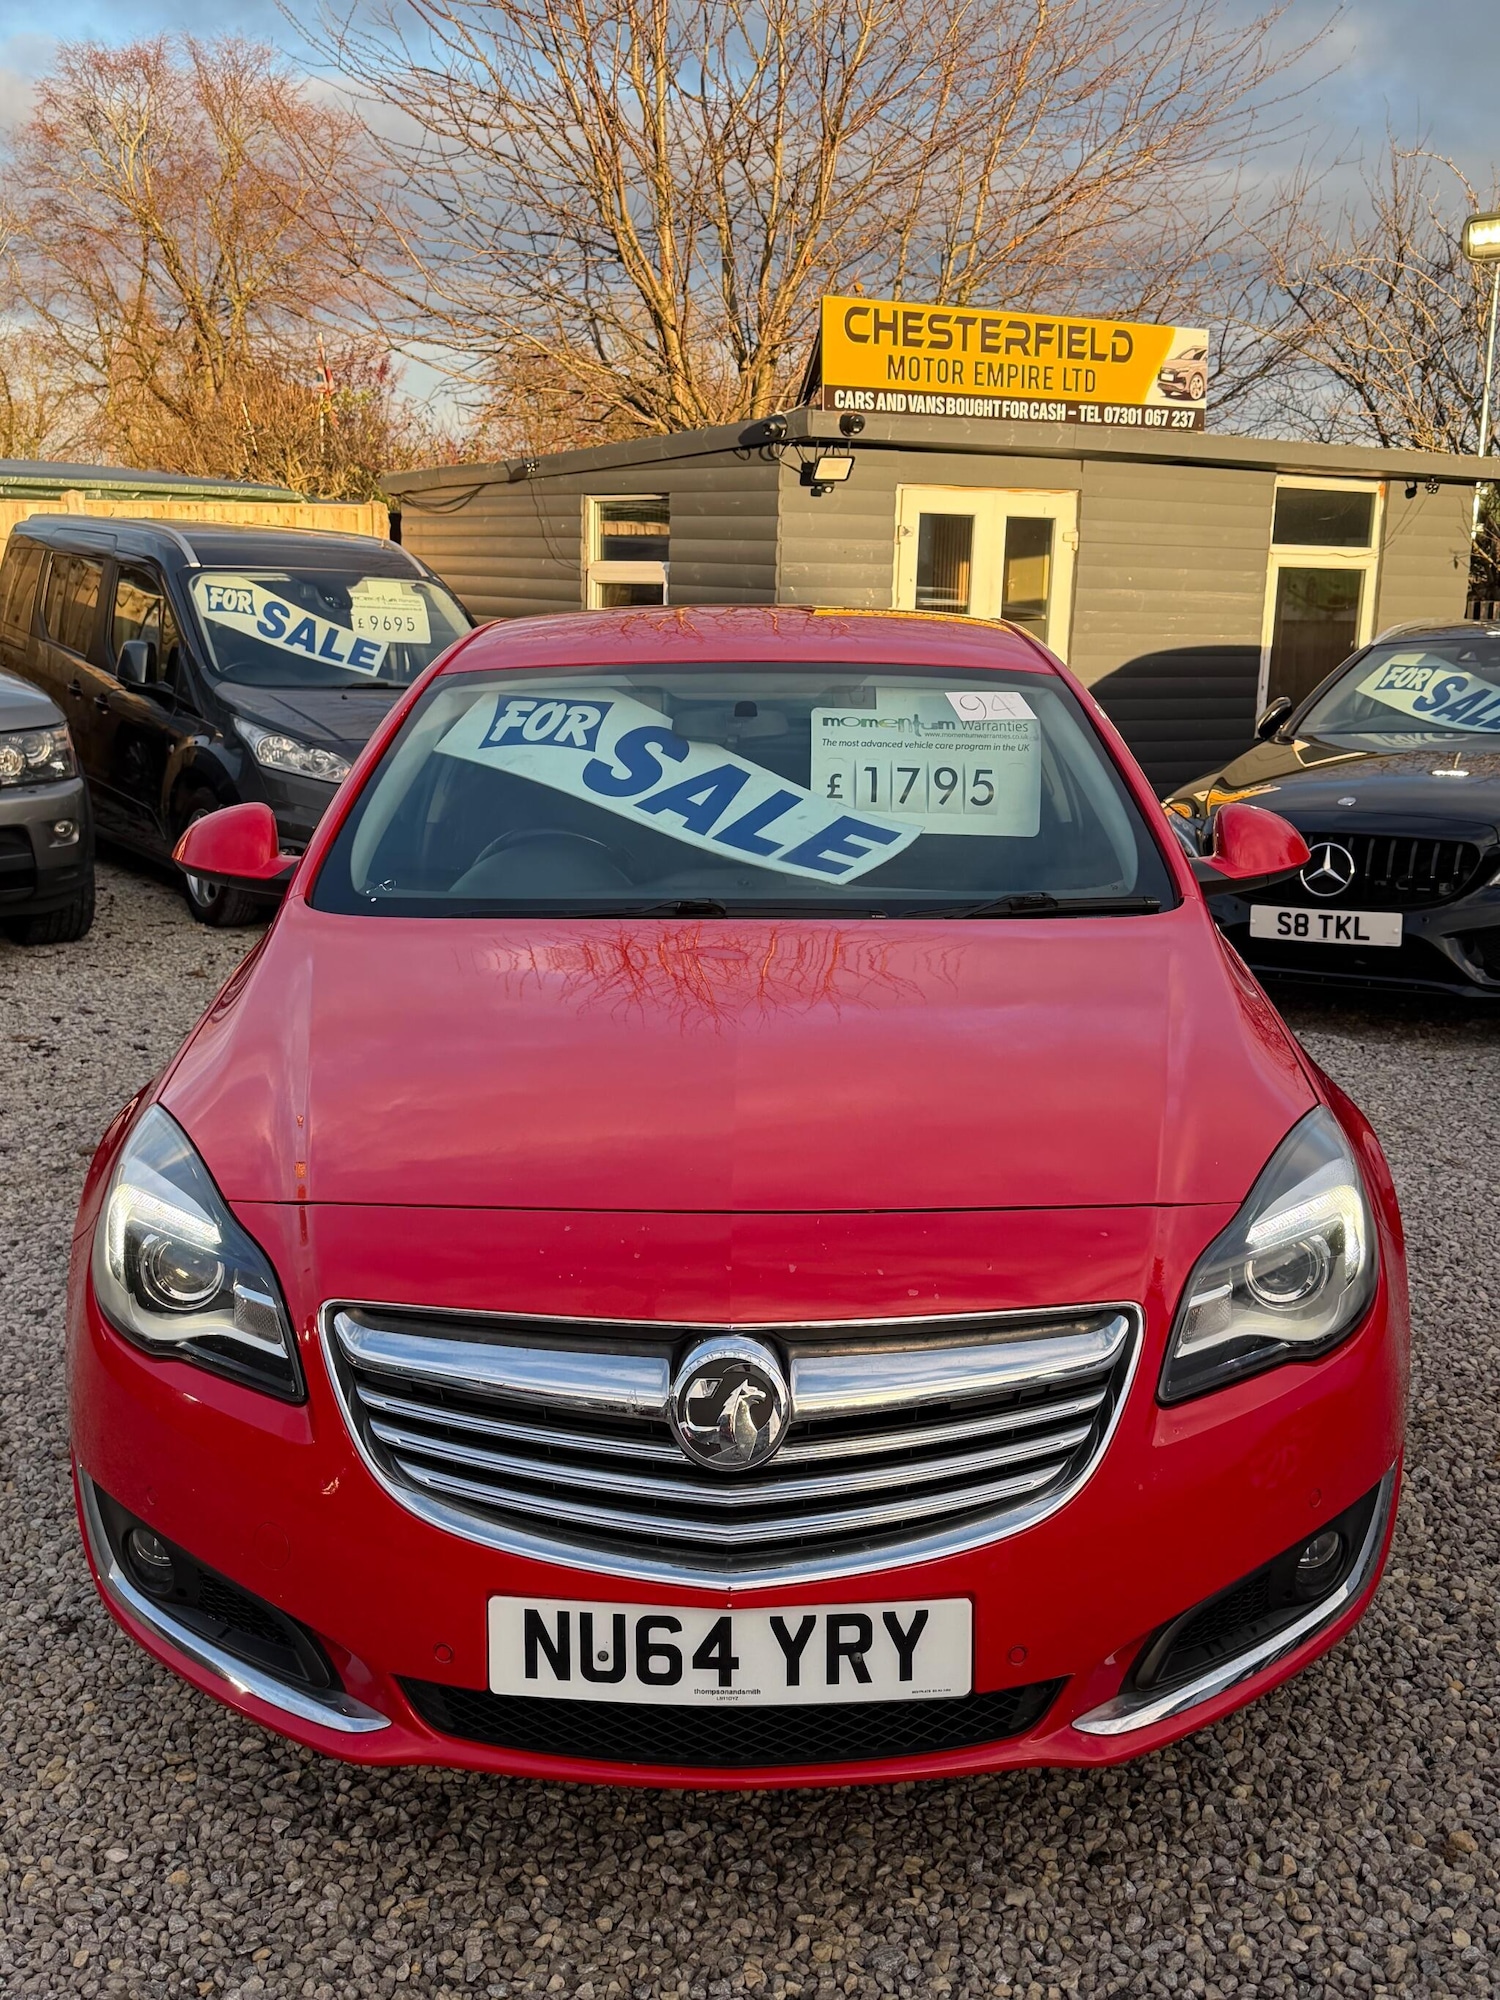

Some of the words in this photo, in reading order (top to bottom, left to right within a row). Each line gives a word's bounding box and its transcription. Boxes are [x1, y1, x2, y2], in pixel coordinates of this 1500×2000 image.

[844, 305, 1134, 364] CHESTERFIELD
[887, 354, 964, 385] MOTOR
[974, 361, 1054, 391] EMPIRE
[1063, 367, 1096, 393] LTD
[834, 389, 875, 411] CARS
[876, 392, 906, 412] AND
[906, 394, 946, 415] VANS
[946, 397, 1002, 418] BOUGHT
[1002, 400, 1028, 419] FOR
[1030, 401, 1067, 421] CASH
[1079, 404, 1102, 423] TEL
[1104, 406, 1142, 425] 07301
[1145, 408, 1169, 426] 067
[1171, 410, 1196, 428] 237
[209, 586, 253, 614] FOR
[256, 601, 382, 671] SALE
[1378, 666, 1434, 691] FOR
[1412, 676, 1500, 730] SAL
[822, 714, 956, 737] momentum
[961, 720, 1029, 733] Warranties
[822, 738, 837, 747] The
[838, 740, 859, 748] most
[860, 740, 903, 749] advanced
[904, 741, 934, 750] vehicle
[955, 743, 992, 752] program
[993, 743, 1001, 751] in
[1002, 743, 1016, 751] the
[1017, 743, 1030, 752] UK
[924, 731, 1029, 740] www.momentumwarranties.co.uk
[490, 699, 603, 747] FOR
[582, 725, 902, 875] SALE
[1277, 912, 1309, 937] S8
[1318, 914, 1370, 941] TKL
[523, 1608, 740, 1687] NU64
[769, 1608, 930, 1685] YRY
[693, 1688, 761, 1696] thompsonandsmith
